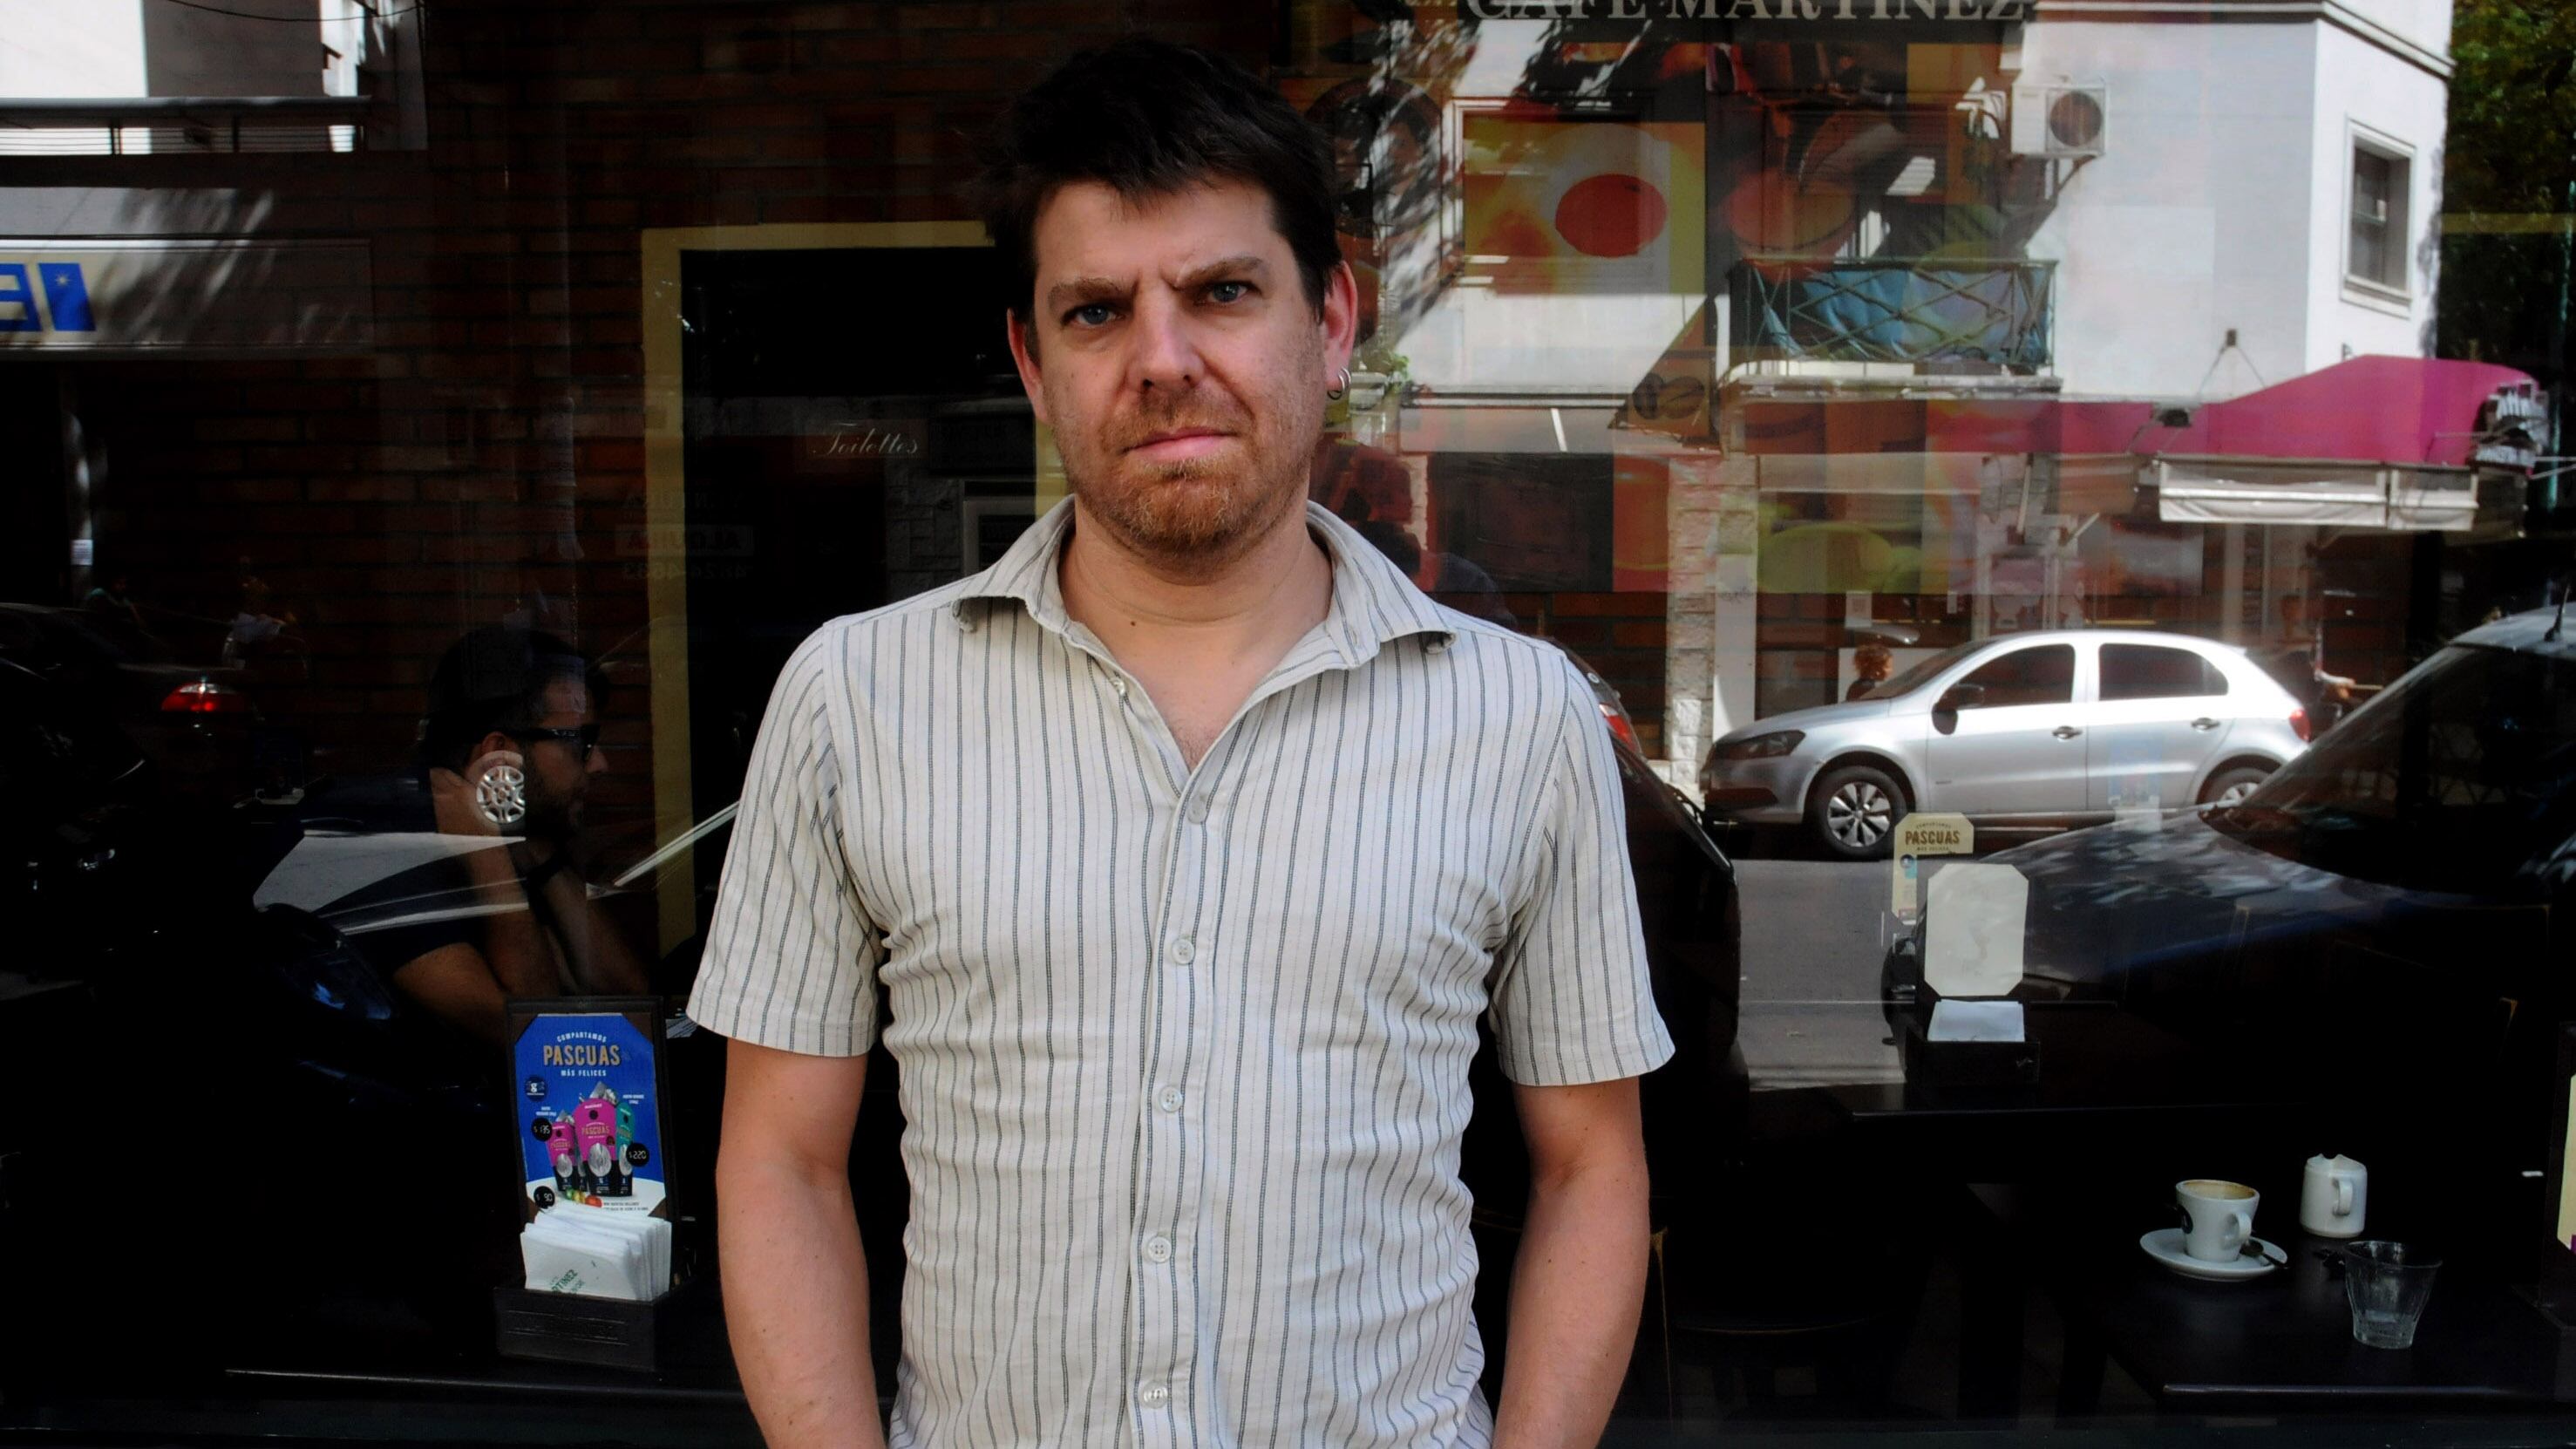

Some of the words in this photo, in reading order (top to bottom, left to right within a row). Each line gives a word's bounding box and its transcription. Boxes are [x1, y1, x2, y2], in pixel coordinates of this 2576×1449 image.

[826, 423, 918, 454] Toilettes
[1906, 831, 1960, 845] PASCUAS
[556, 1031, 607, 1042] COMPARTAMOS
[543, 1044, 621, 1065] PASCUAS
